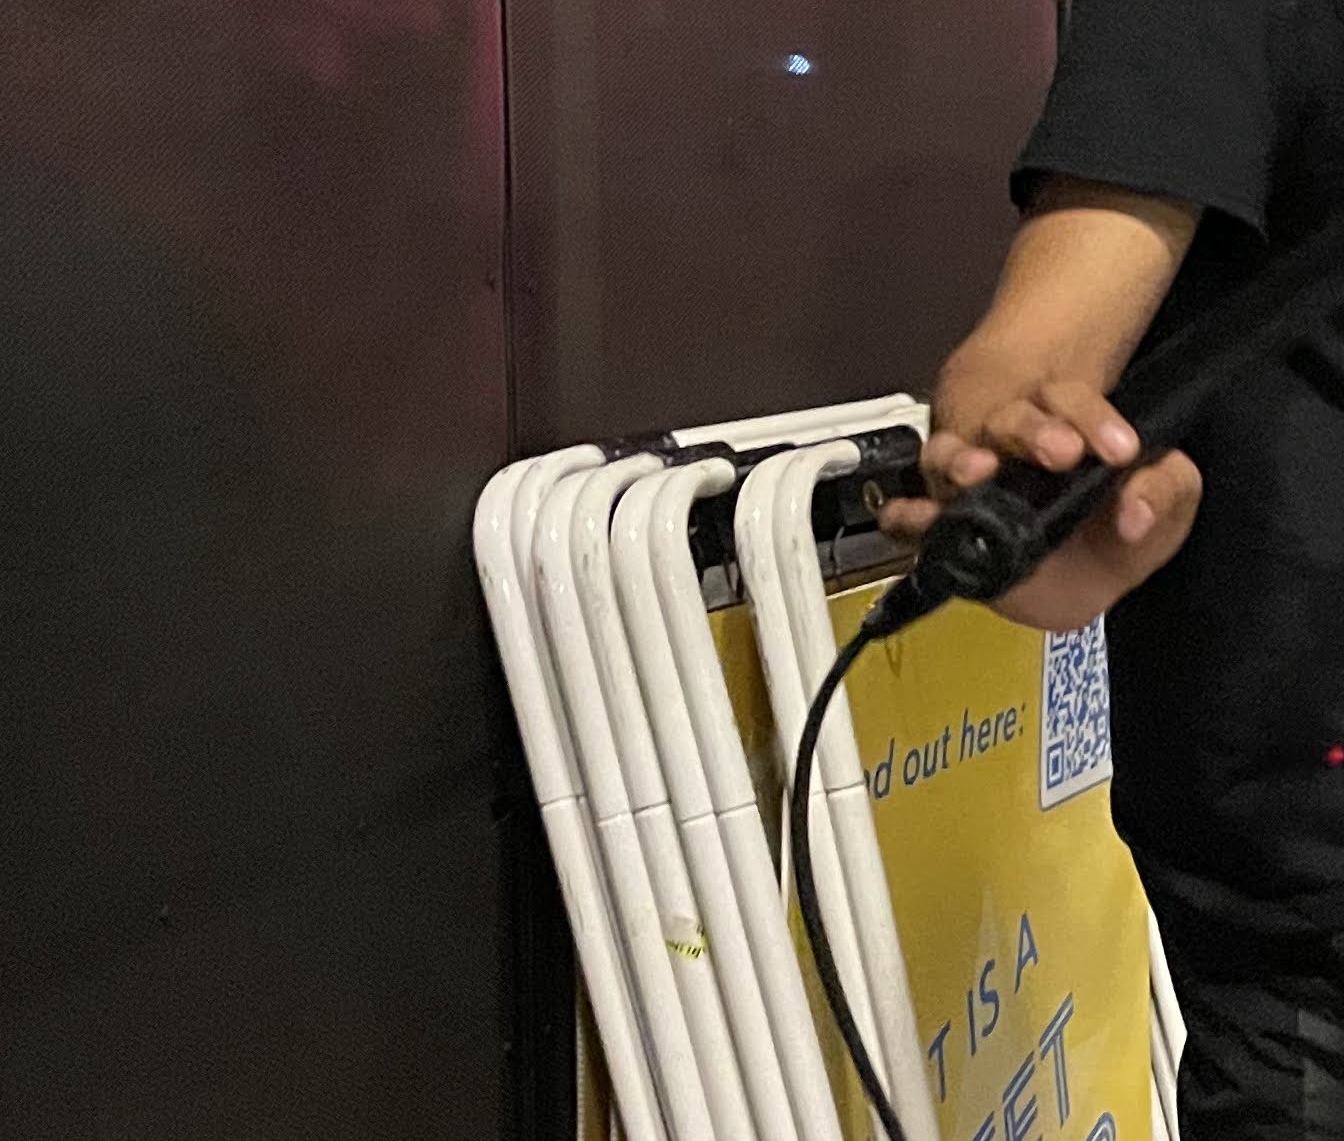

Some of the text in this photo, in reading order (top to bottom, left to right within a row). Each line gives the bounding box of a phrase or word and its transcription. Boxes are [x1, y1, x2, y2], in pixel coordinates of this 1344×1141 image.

[903, 722, 951, 785] out
[960, 702, 1026, 763] here:
[966, 958, 1000, 1057] IS
[1014, 910, 1038, 994] A
